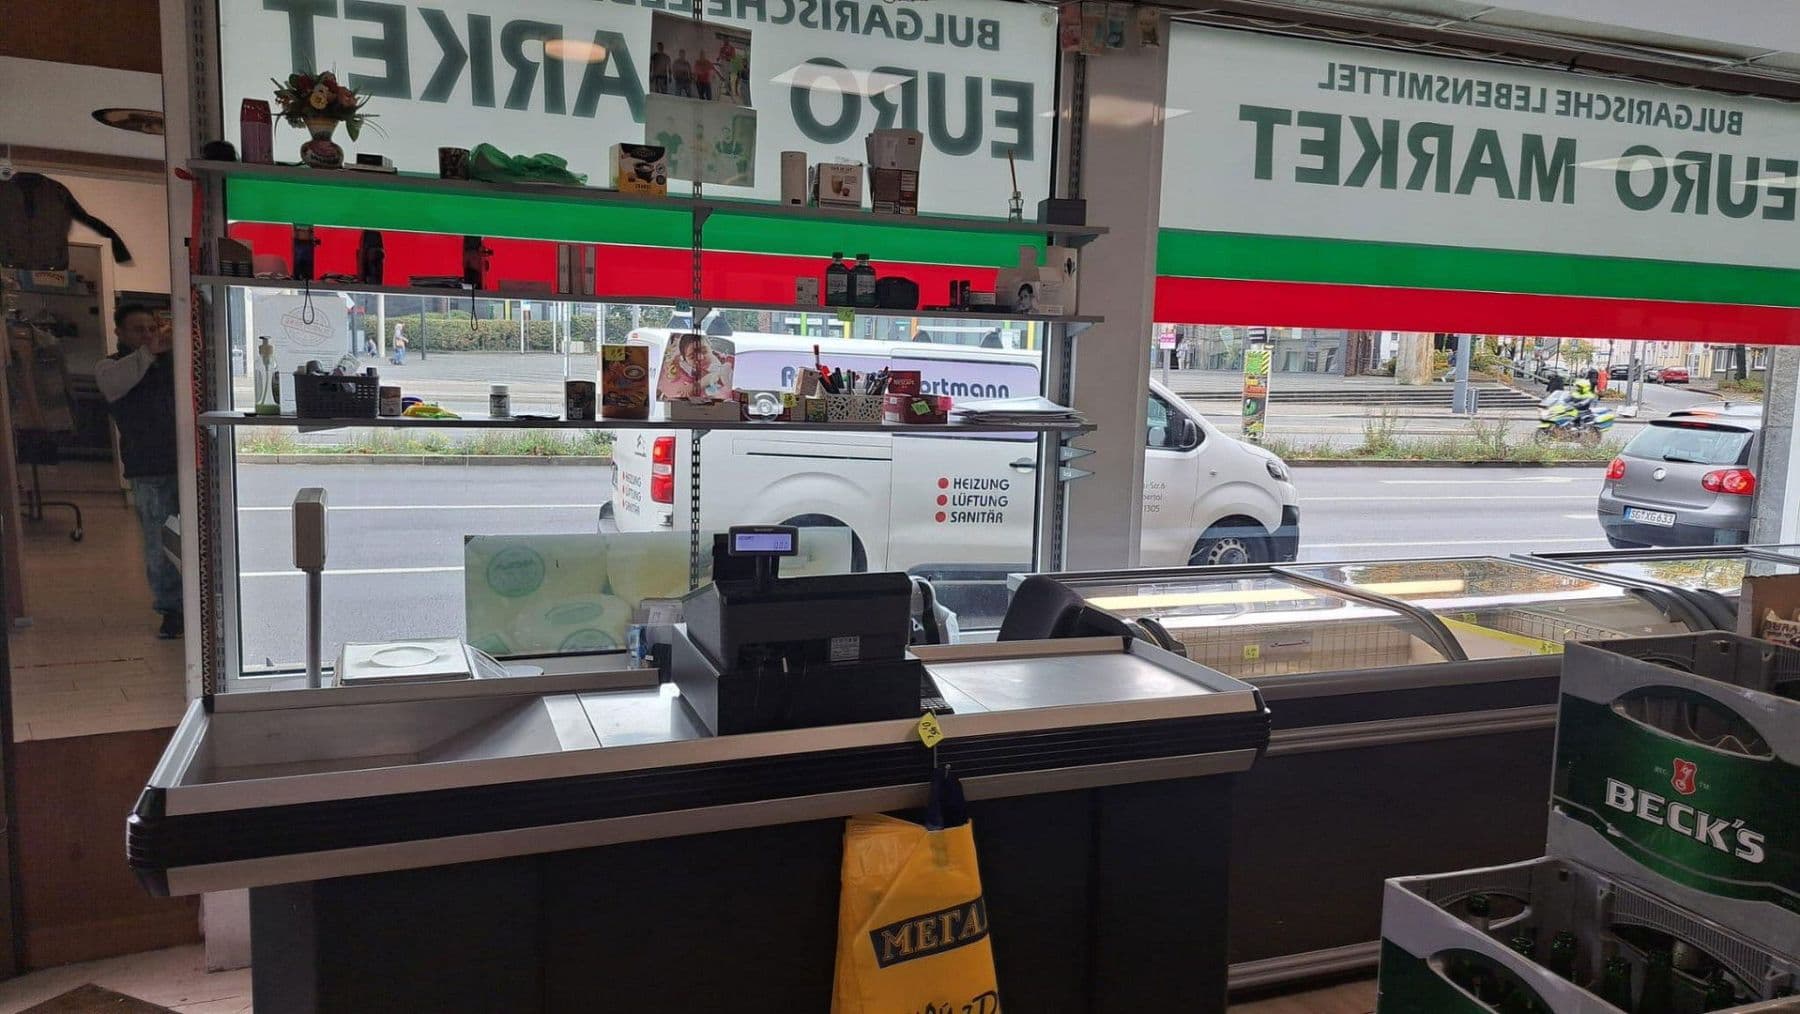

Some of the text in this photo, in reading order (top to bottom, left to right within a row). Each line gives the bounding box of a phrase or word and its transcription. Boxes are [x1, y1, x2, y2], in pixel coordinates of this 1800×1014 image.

[921, 378, 1009, 399] ortmann
[953, 478, 1010, 491] HEIZUNG
[952, 492, 1009, 507] LÜFTUNG
[950, 509, 1003, 523] SANITÄR
[1605, 777, 1765, 865] BECK'S
